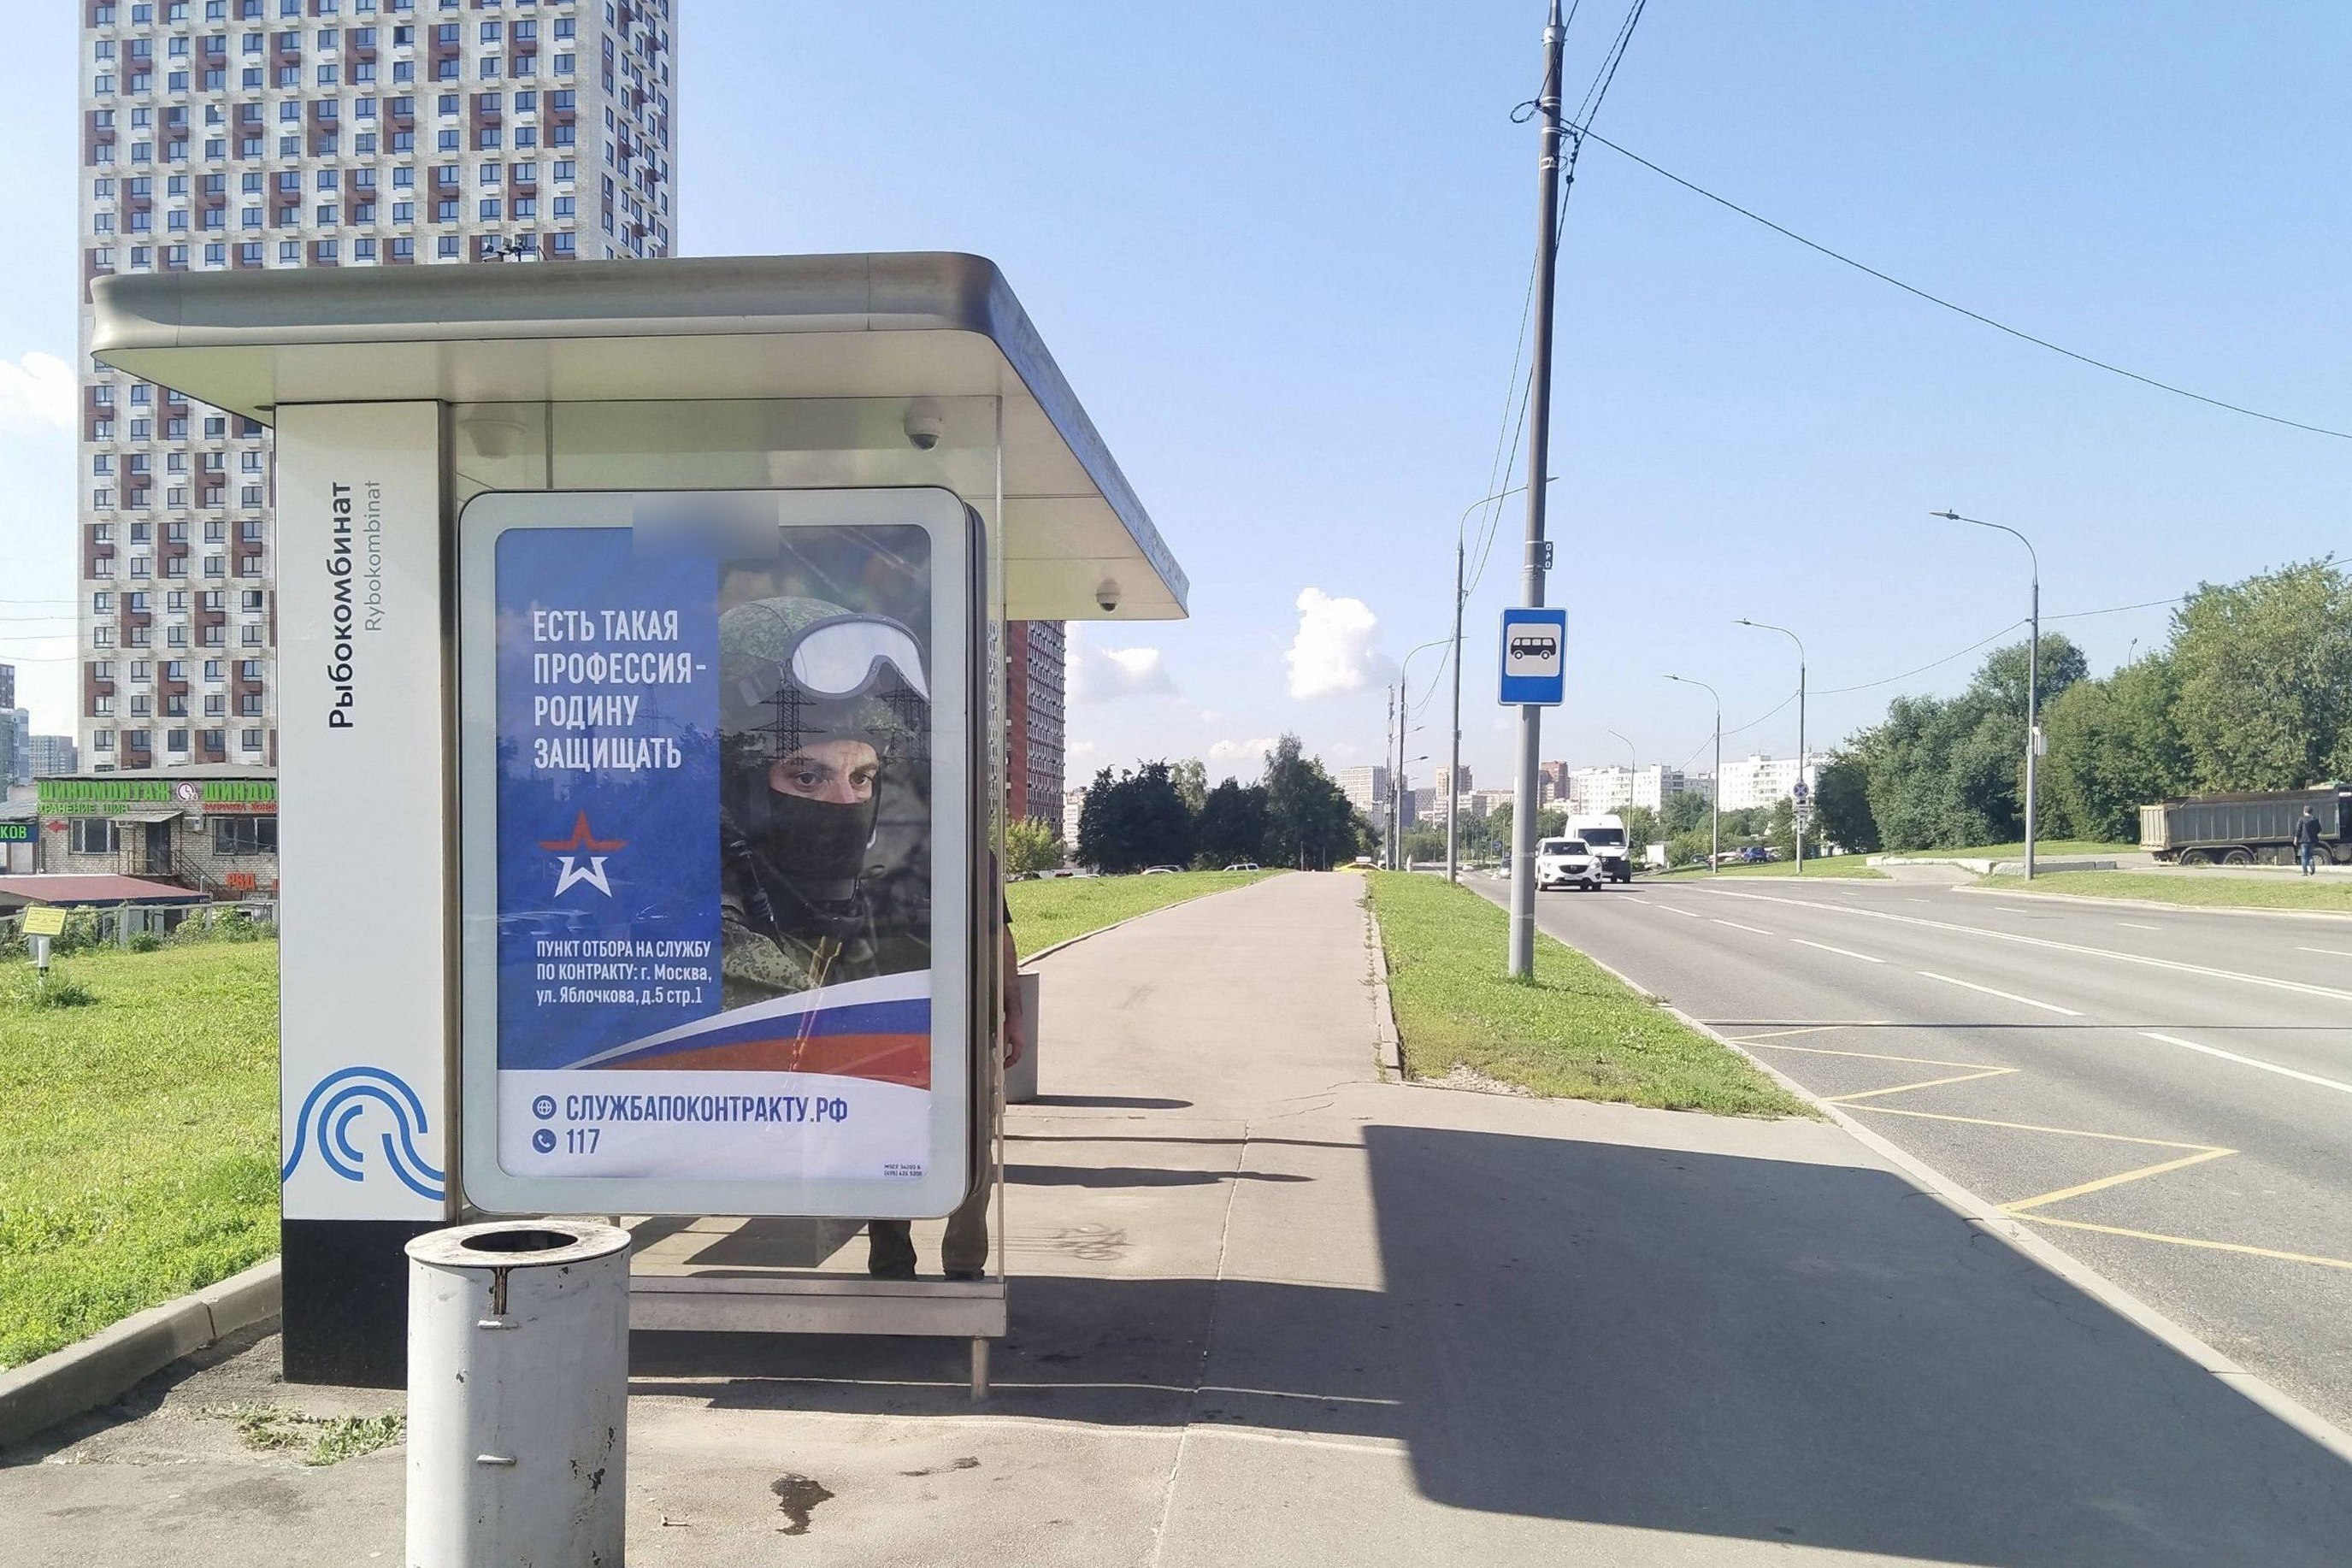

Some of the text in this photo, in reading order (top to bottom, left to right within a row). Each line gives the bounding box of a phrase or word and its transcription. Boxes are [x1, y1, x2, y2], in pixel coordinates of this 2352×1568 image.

[363, 480, 386, 632] Rybokombinat
[326, 481, 354, 728] Рыбокомбинат
[533, 610, 679, 642] ЕСТЬ ТАКАЯ
[533, 694, 640, 730] РОДИНУ
[533, 737, 682, 773] ЗАЩИЩАТЬ
[38, 781, 170, 801] ШИНОМОНТАЖ
[37, 803, 129, 814] ХРАНЕНИЕ ШИН
[0, 825, 27, 839] КОВ
[536, 940, 711, 958] ПУНКТ ОТБОРА НА СЛУЖБУ
[536, 964, 712, 984] ПО КОНТРАКТУ: г. Москва,
[536, 990, 557, 1006] ул.
[667, 987, 703, 1006] стр.1
[566, 1094, 848, 1124] СЛУЖБАПОКОНТРАКТУ.РФ
[566, 1129, 601, 1154] 117
